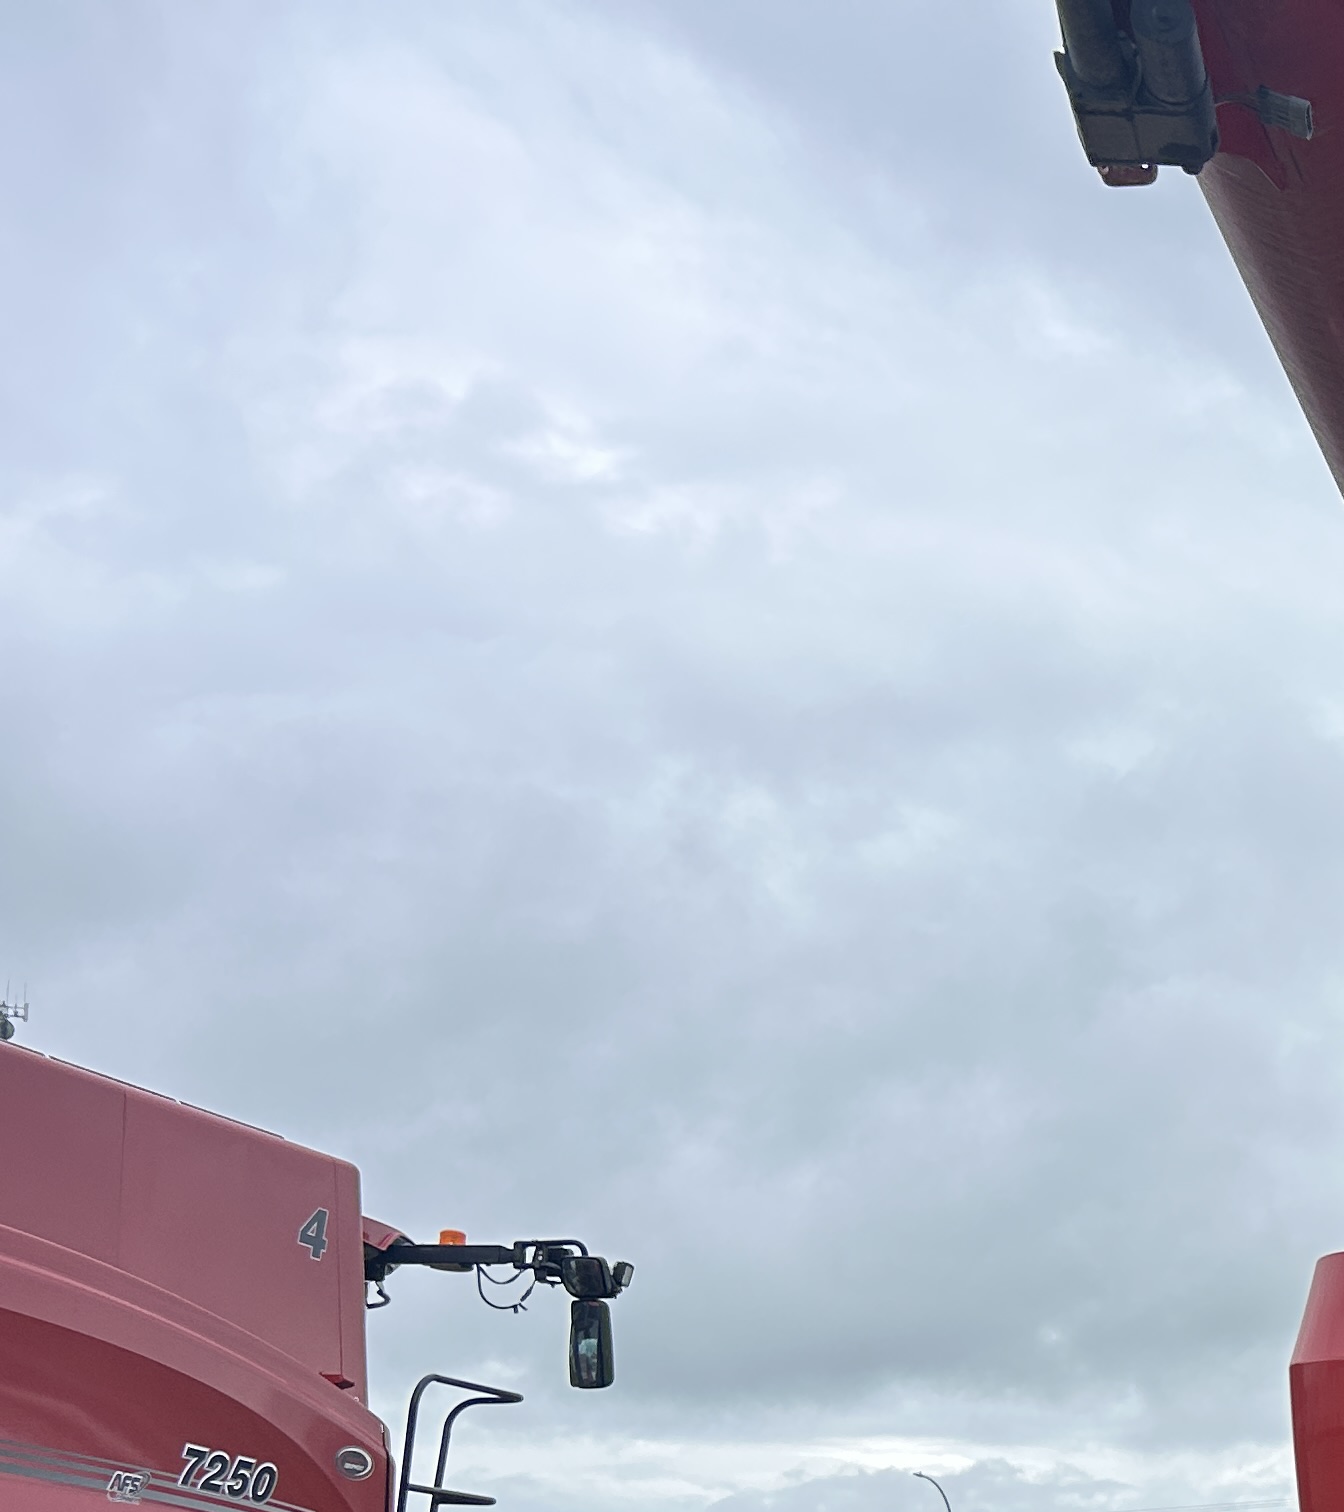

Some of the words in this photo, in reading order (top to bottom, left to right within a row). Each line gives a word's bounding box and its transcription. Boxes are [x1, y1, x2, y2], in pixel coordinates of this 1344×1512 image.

[297, 1207, 329, 1261] 4
[107, 1471, 144, 1494] AFS
[178, 1443, 278, 1505] 7250
